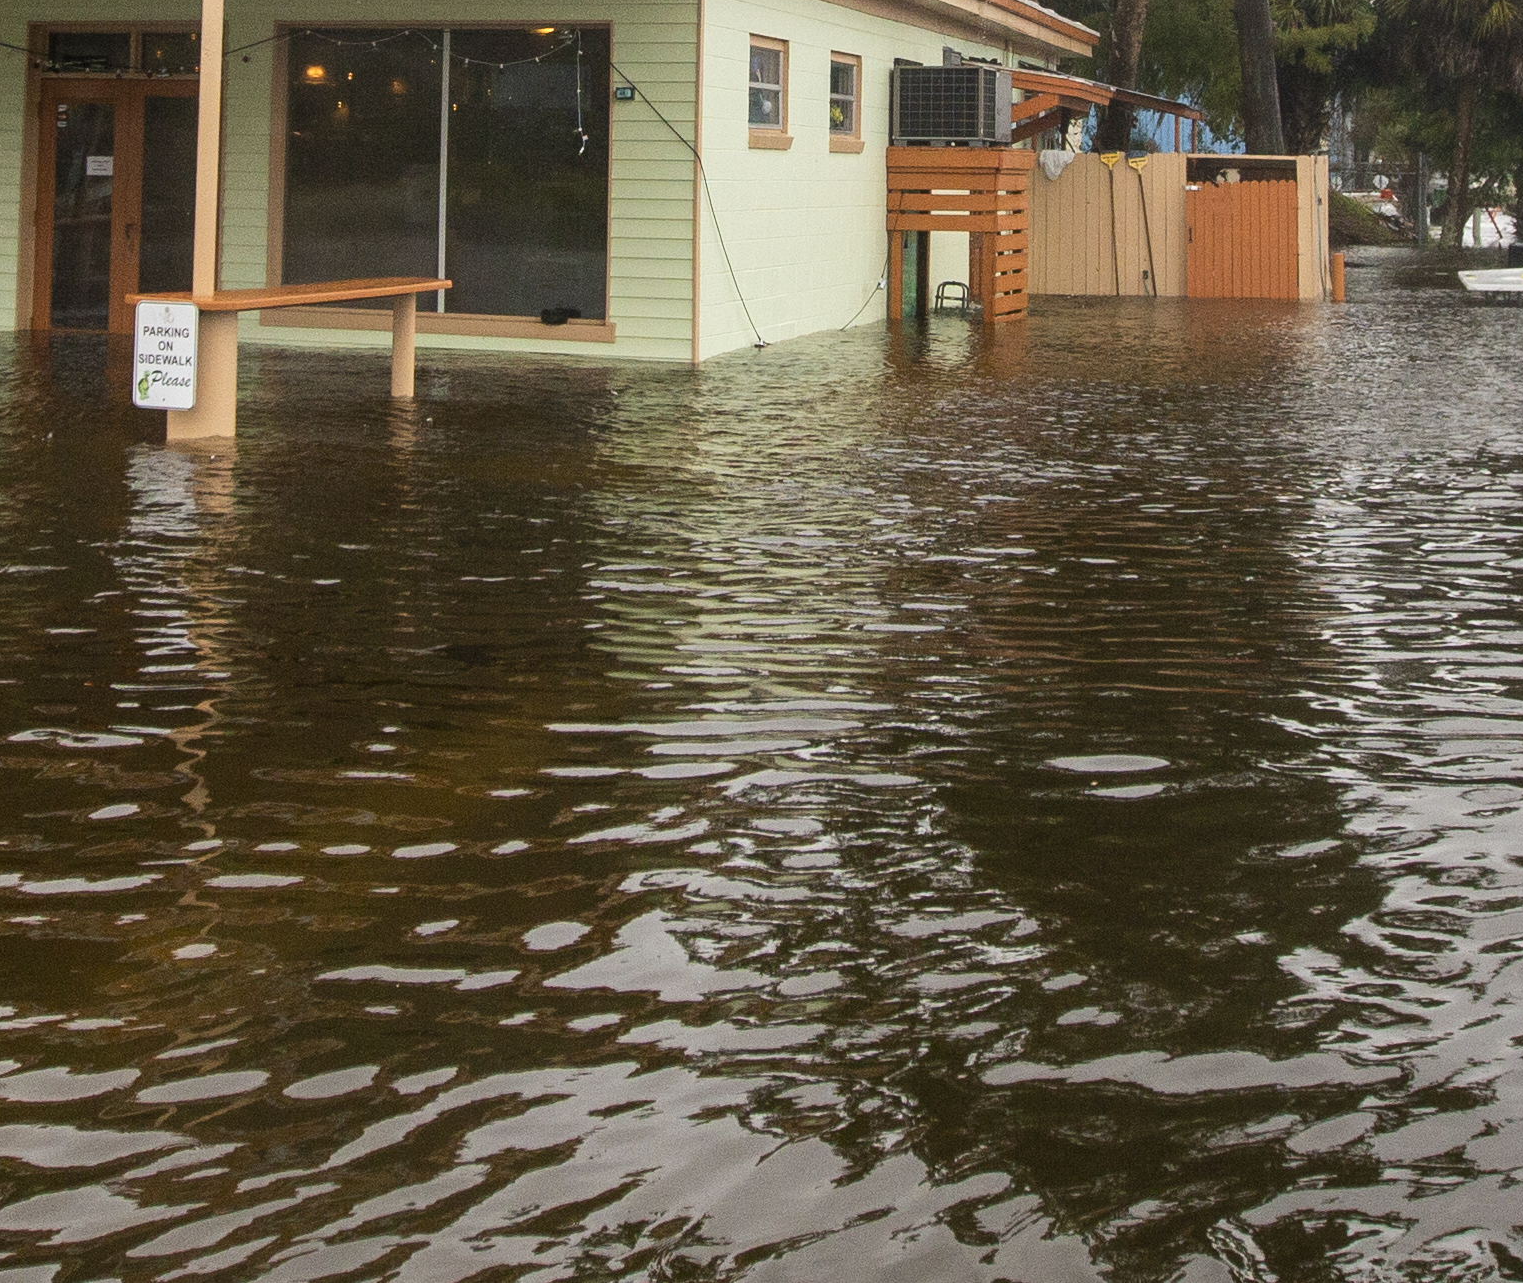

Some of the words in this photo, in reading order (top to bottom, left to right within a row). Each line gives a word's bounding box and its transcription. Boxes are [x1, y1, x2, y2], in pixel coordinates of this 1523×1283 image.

[143, 326, 190, 339] PARKING
[158, 340, 174, 352] ON
[138, 353, 193, 367] SIDEWALK
[150, 369, 192, 388] Please
